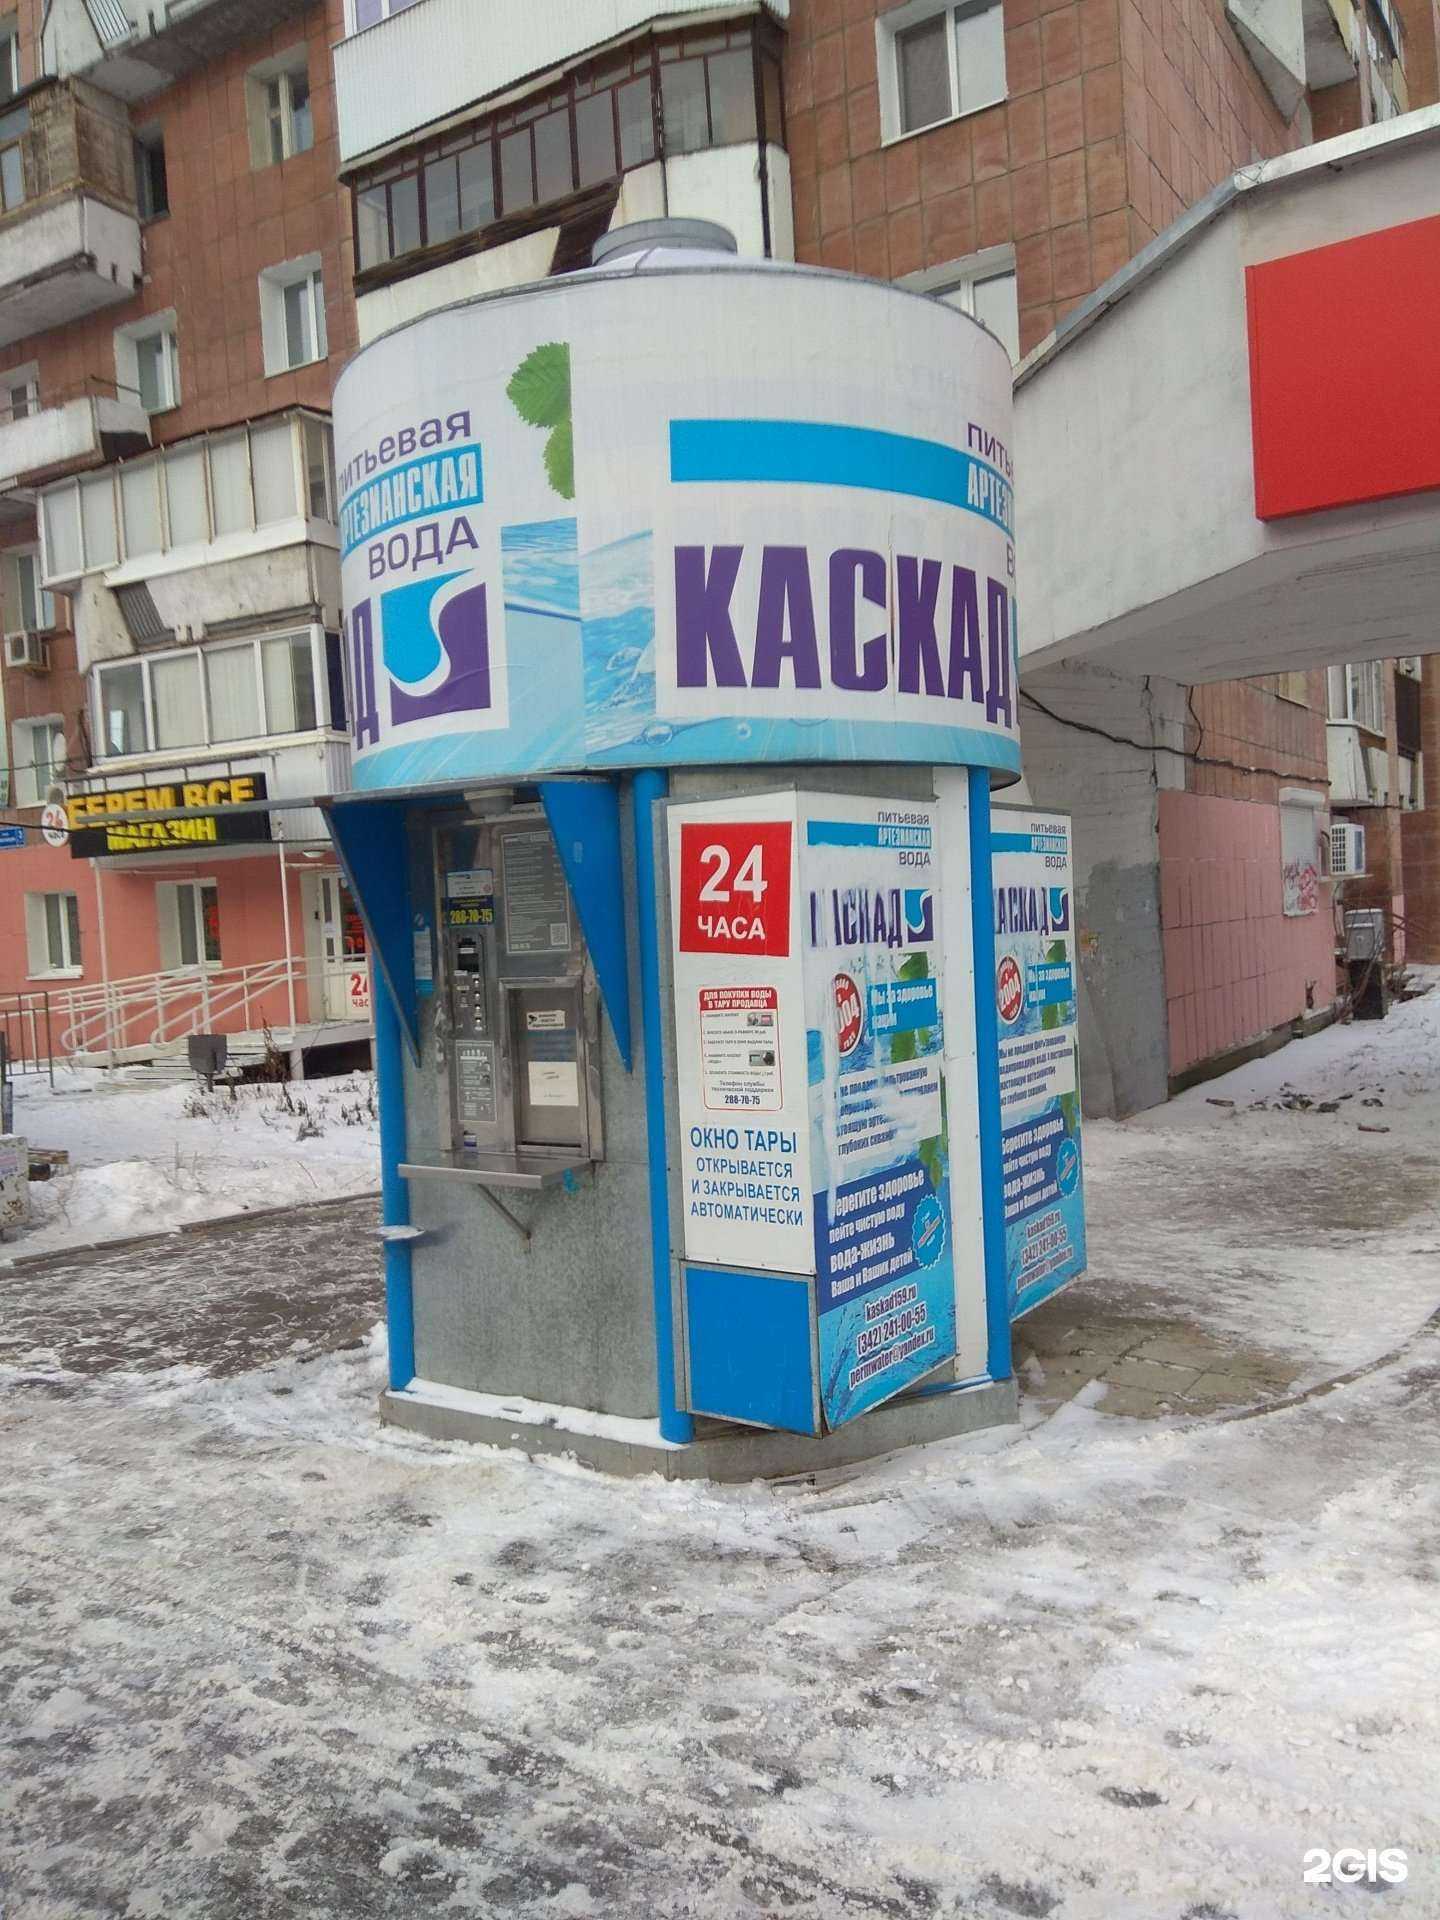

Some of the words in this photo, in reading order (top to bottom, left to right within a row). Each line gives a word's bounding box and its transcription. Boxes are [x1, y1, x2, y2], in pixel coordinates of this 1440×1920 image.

[369, 516, 480, 580] ВОДА
[674, 544, 1012, 729] КАСКАД
[878, 811, 930, 825] питьевая
[106, 815, 218, 850] МАГАЗИН
[899, 851, 932, 867] ВОДА
[1045, 856, 1068, 869] ВОДА
[699, 844, 768, 903] 24
[697, 915, 766, 941] ЧАСА
[724, 1094, 761, 1105] 288-70-75
[690, 1127, 739, 1150] ОКНО
[744, 1129, 797, 1153] ТАРЫ
[696, 1157, 792, 1178] ОТКРЫВАЕТСЯ
[691, 1179, 700, 1194] И
[703, 1180, 800, 1203] ЗАКРЫВАЕТСЯ
[832, 1181, 877, 1217] ерегите
[878, 1169, 925, 1202] здоровье
[690, 1202, 803, 1227] АВТОМАТИЧЕСКИ
[829, 1223, 855, 1244] пейте
[830, 1231, 895, 1274] вода-жизнь
[866, 1284, 917, 1321] kaskad159.ru
[883, 1303, 926, 1342] 241-00-55
[849, 1326, 935, 1388] permwater@yandex.ru
